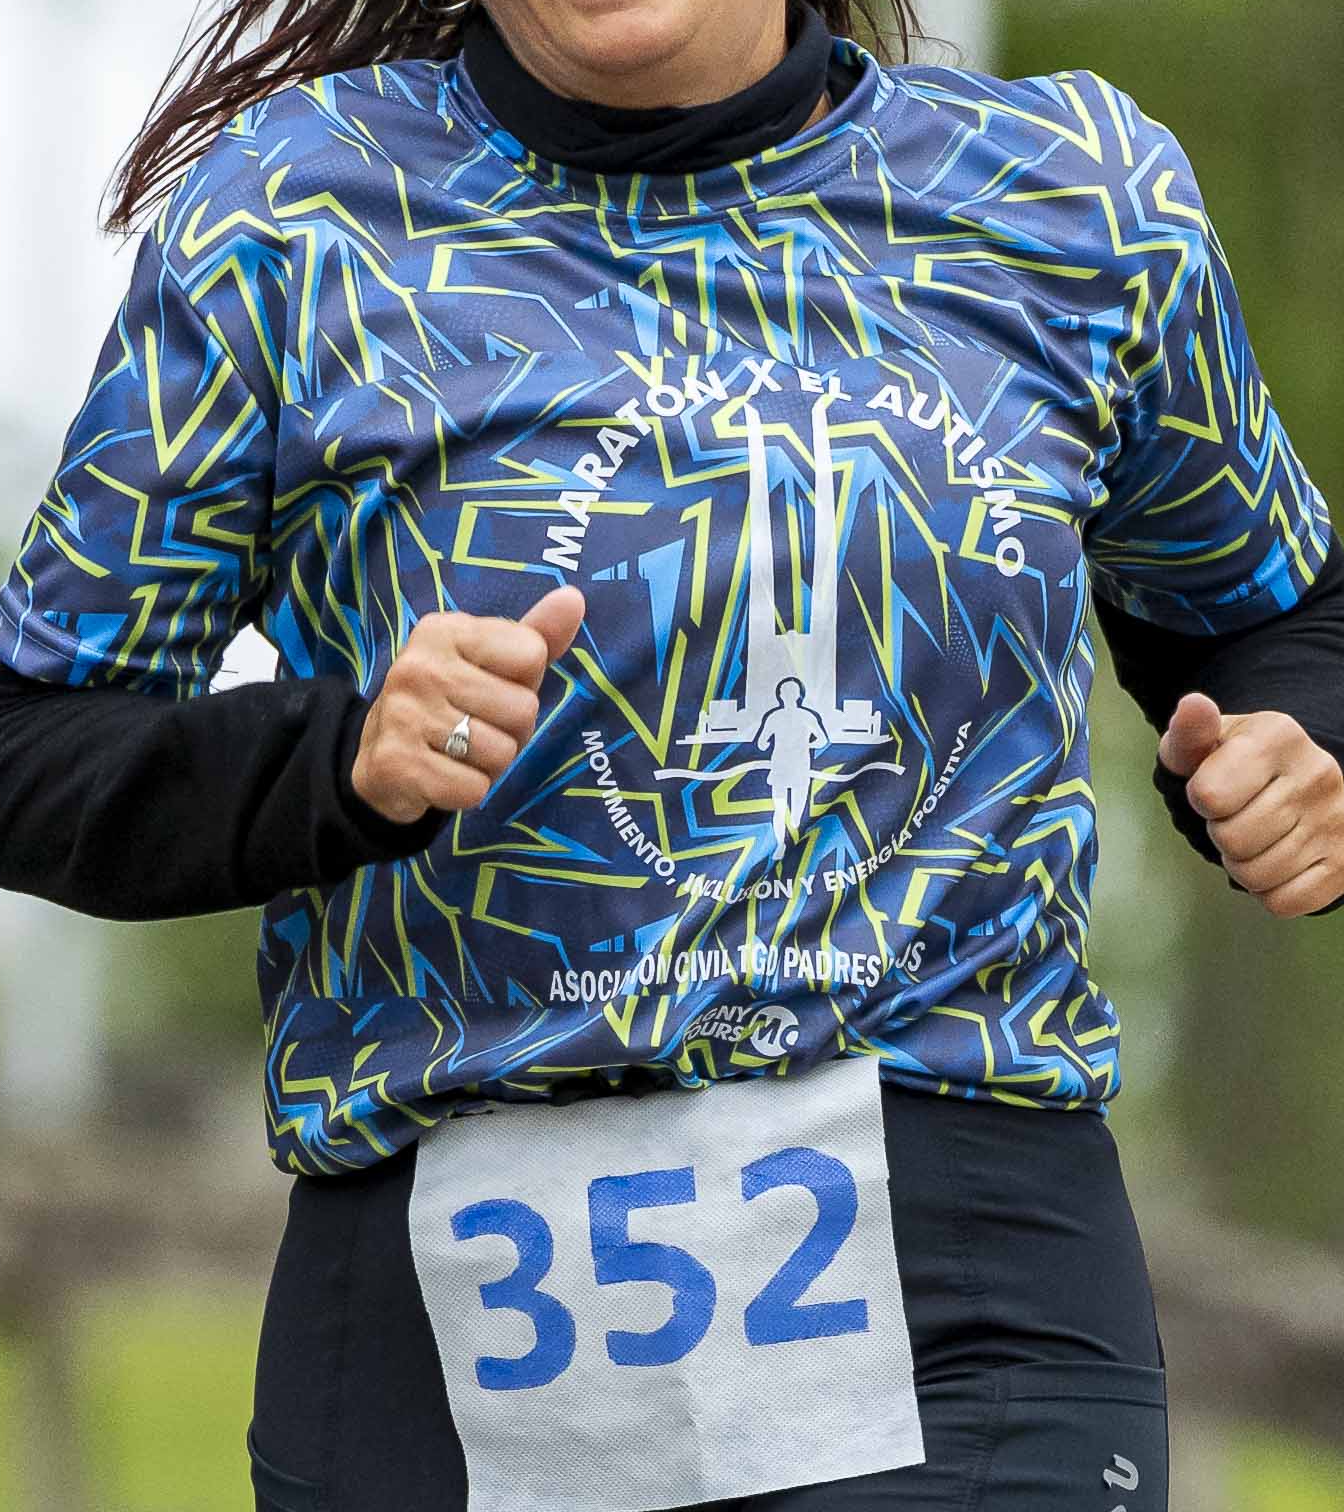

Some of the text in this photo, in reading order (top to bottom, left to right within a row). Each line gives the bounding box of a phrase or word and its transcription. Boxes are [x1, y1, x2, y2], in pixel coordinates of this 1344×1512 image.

[541, 359, 1025, 578] MARATON X EL AUTISMO
[581, 730, 677, 886] MOVIMIENTO,
[800, 874, 815, 895] Y
[823, 827, 912, 892] ENERGÍA
[913, 721, 972, 829] POSITIVA
[674, 949, 732, 984] CIVIL
[737, 943, 778, 977] TGD
[784, 946, 882, 988] PADRES
[449, 1146, 871, 1392] 352
